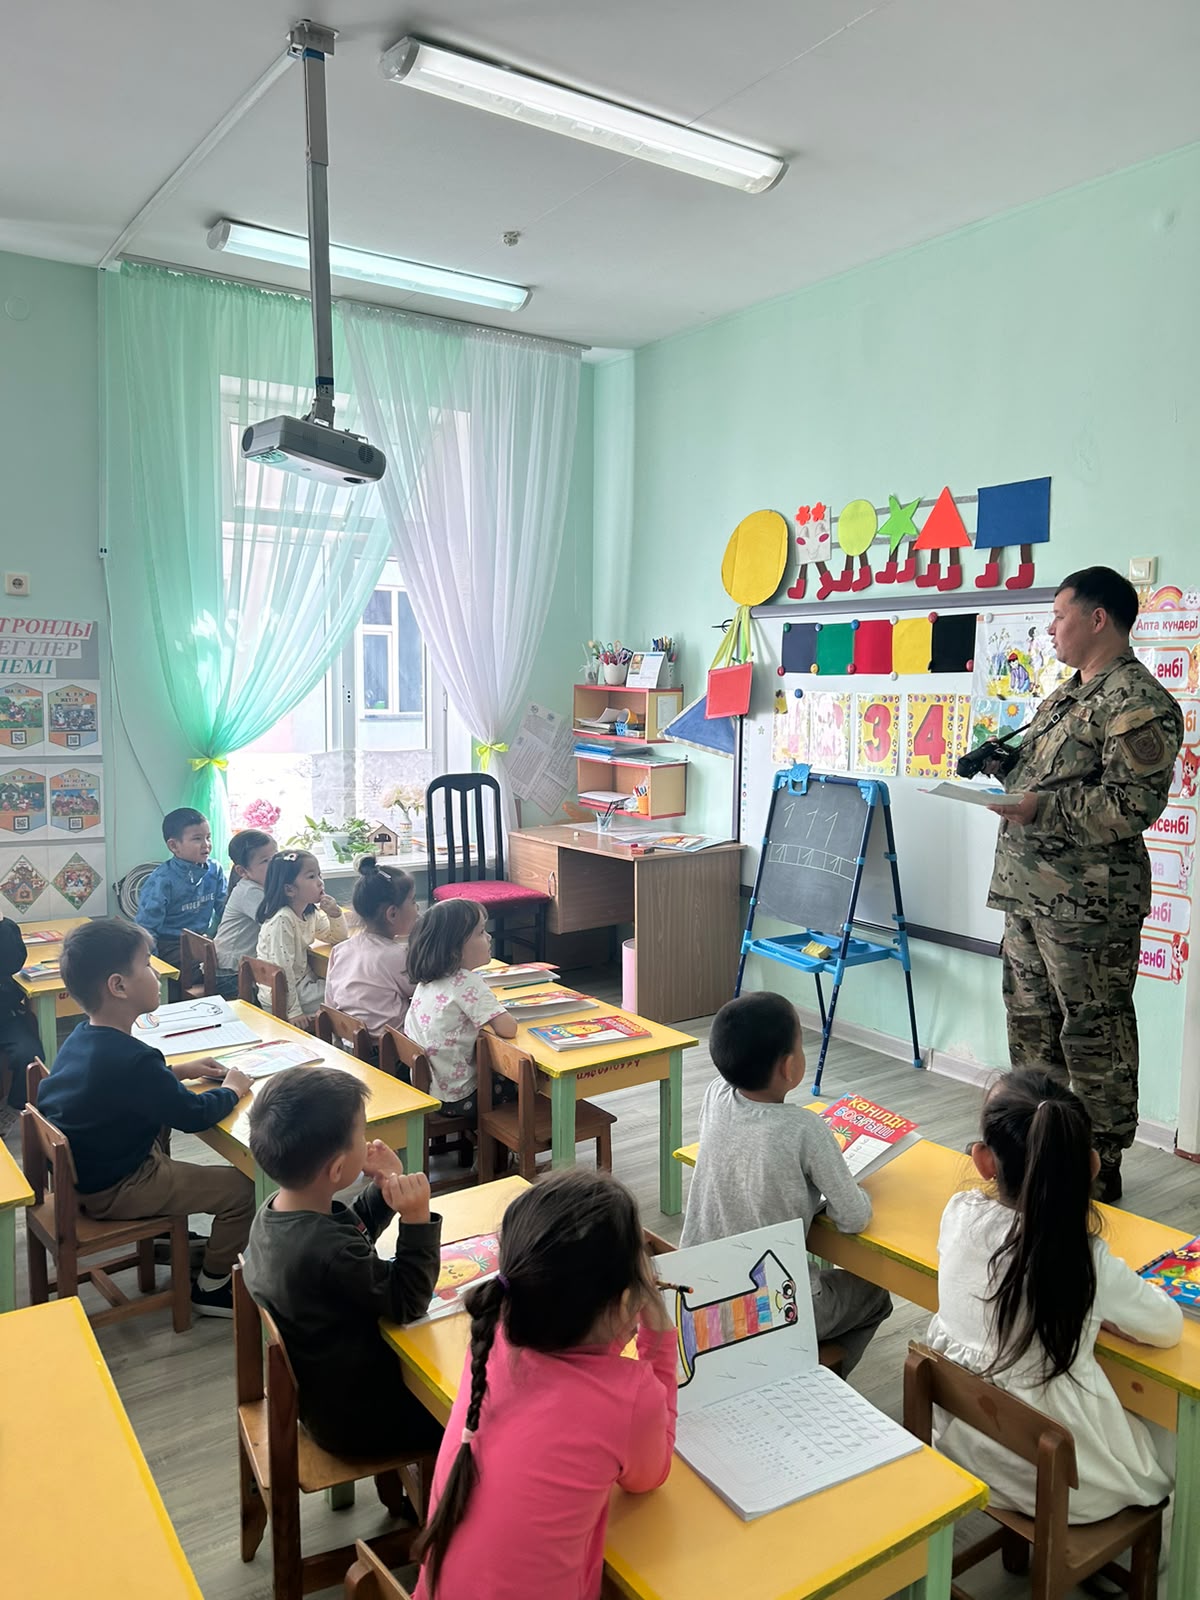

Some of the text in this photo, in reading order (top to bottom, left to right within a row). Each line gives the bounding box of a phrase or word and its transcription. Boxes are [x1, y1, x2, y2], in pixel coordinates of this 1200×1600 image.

[1136, 616, 1199, 632] Апта күндері
[1154, 658, 1183, 678] енбі
[863, 703, 892, 763] 3
[913, 704, 947, 765] 4
[784, 802, 839, 849] 1 1 1
